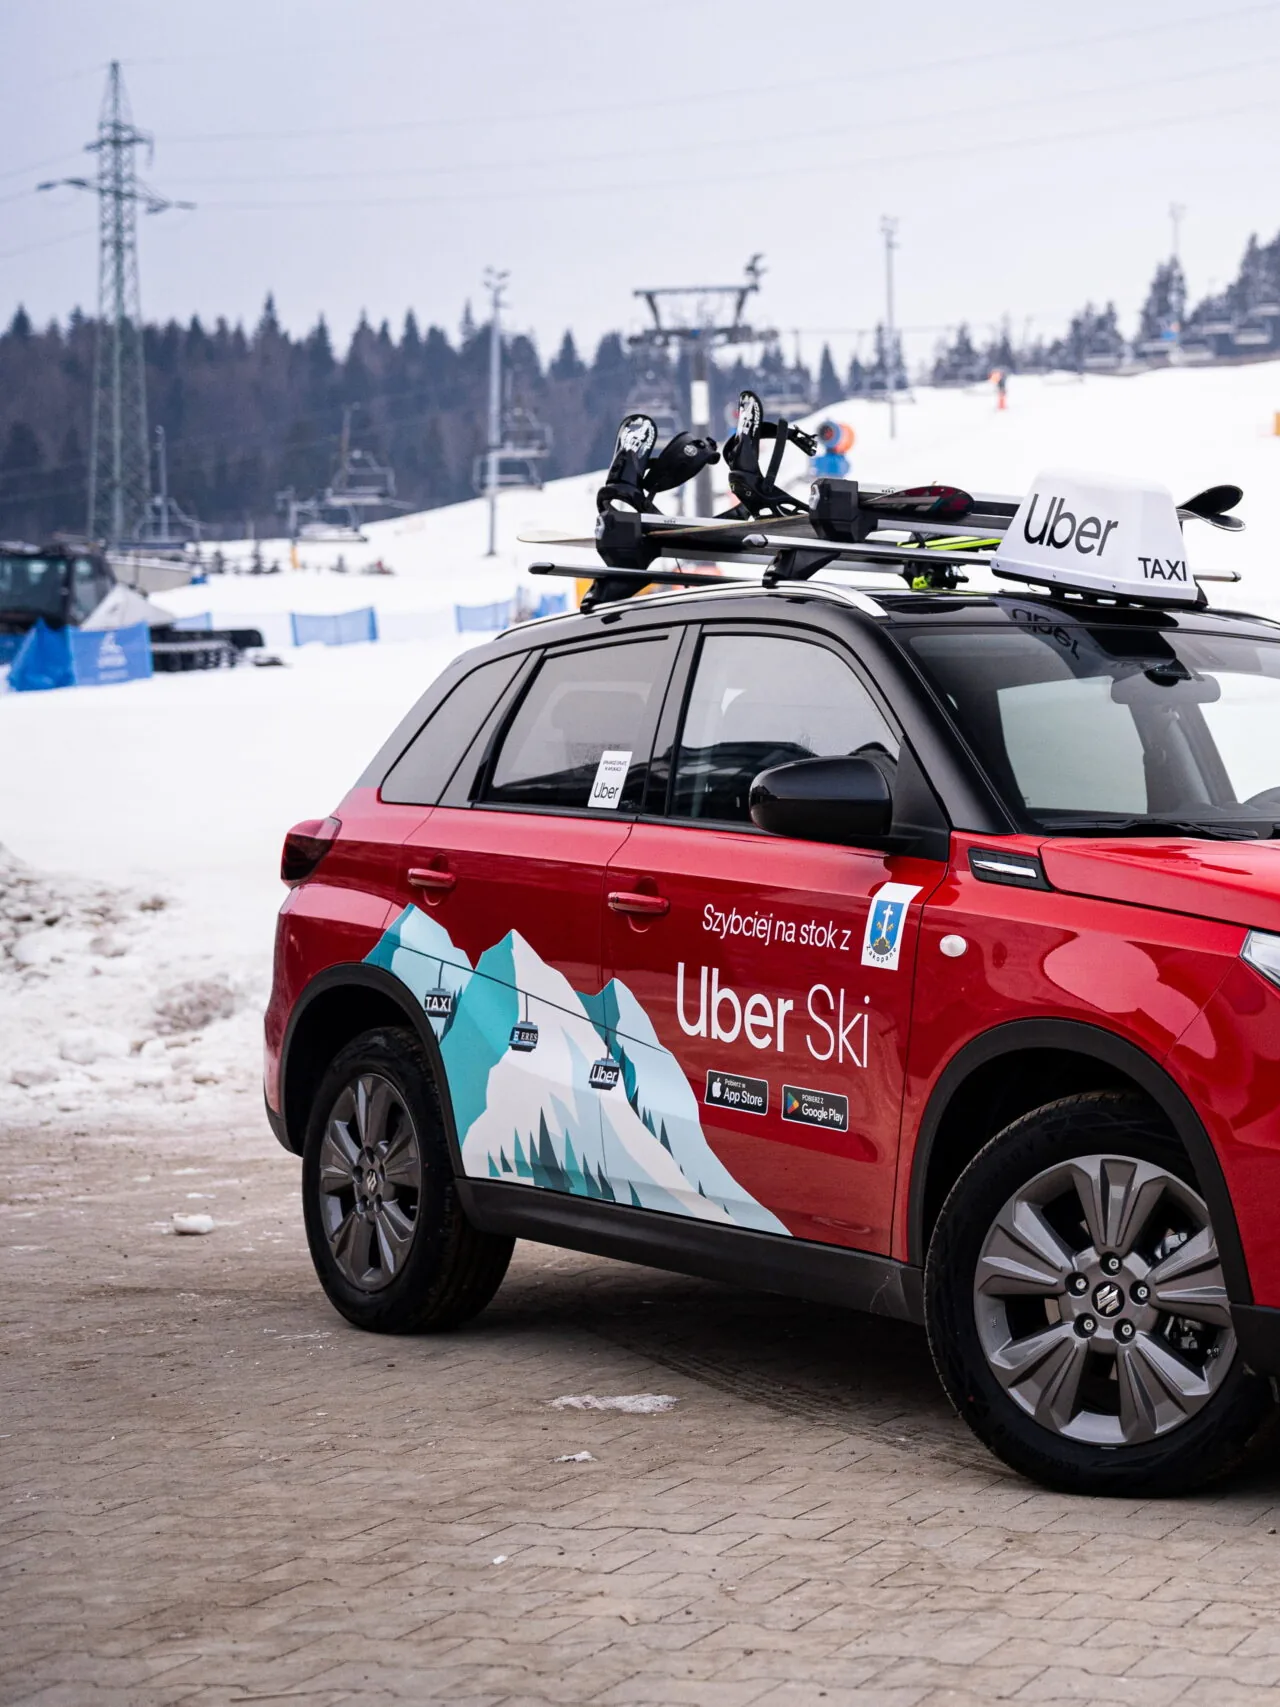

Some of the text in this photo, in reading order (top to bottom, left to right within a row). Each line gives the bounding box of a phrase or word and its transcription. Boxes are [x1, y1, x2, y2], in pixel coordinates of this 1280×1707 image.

[1024, 493, 1119, 556] Uber
[1138, 557, 1188, 581] TAXI
[594, 782, 620, 799] Uber
[702, 903, 852, 950] Szybciej na stok z
[425, 996, 452, 1012] TAXI
[676, 961, 870, 1068] Uber Ski
[520, 1031, 538, 1042] ERES
[592, 1066, 618, 1083] Uber
[723, 1087, 763, 1107] App Store
[802, 1103, 844, 1124] Google Play
